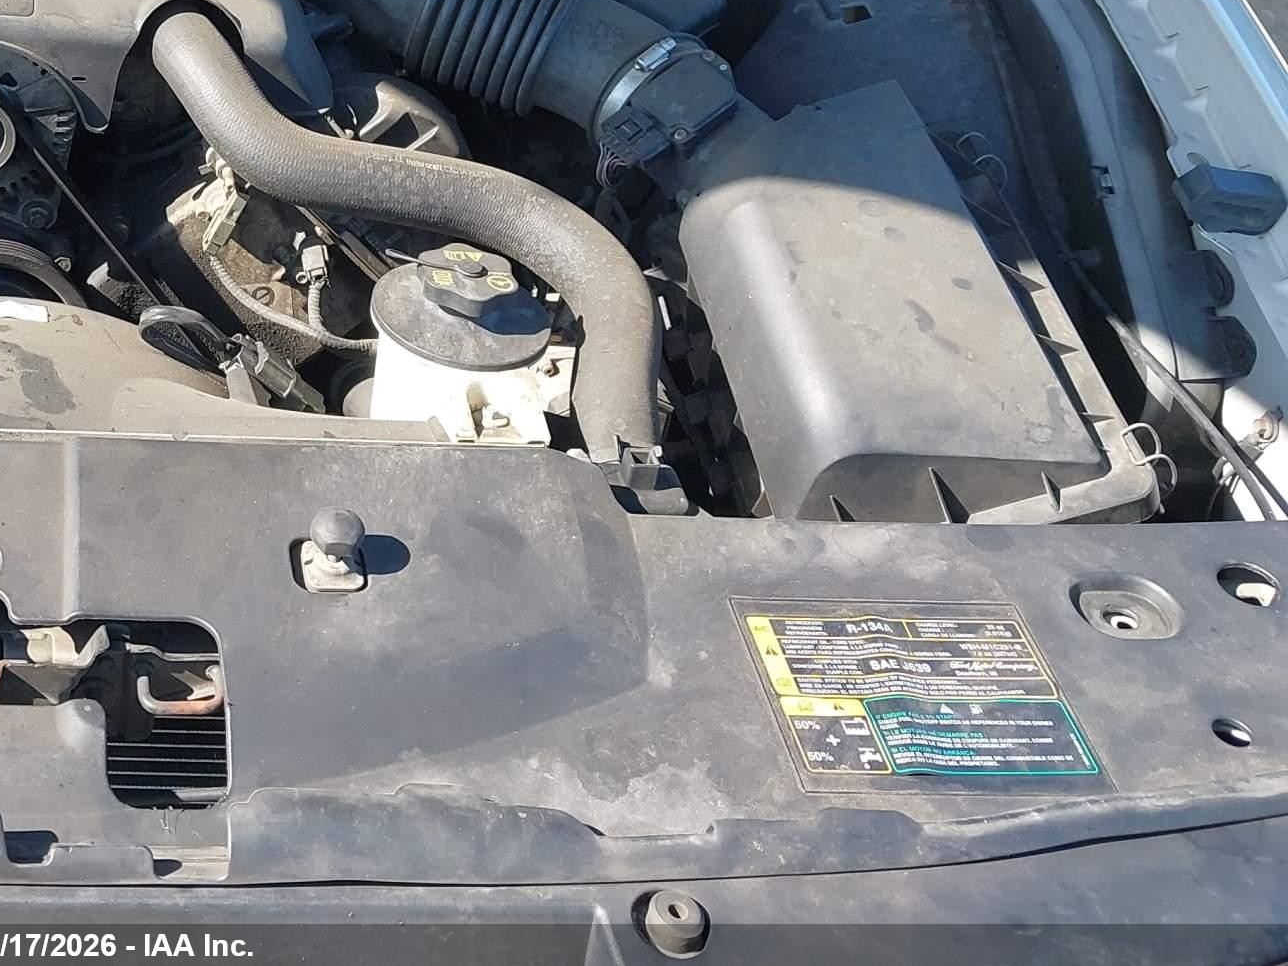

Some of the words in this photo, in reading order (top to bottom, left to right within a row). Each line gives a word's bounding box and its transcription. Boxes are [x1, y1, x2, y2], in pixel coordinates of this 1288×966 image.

[845, 620, 894, 634] R-134A
[868, 658, 901, 671] SAE
[902, 661, 932, 674] J639
[793, 720, 821, 730] 50%
[807, 750, 835, 762] 50%
